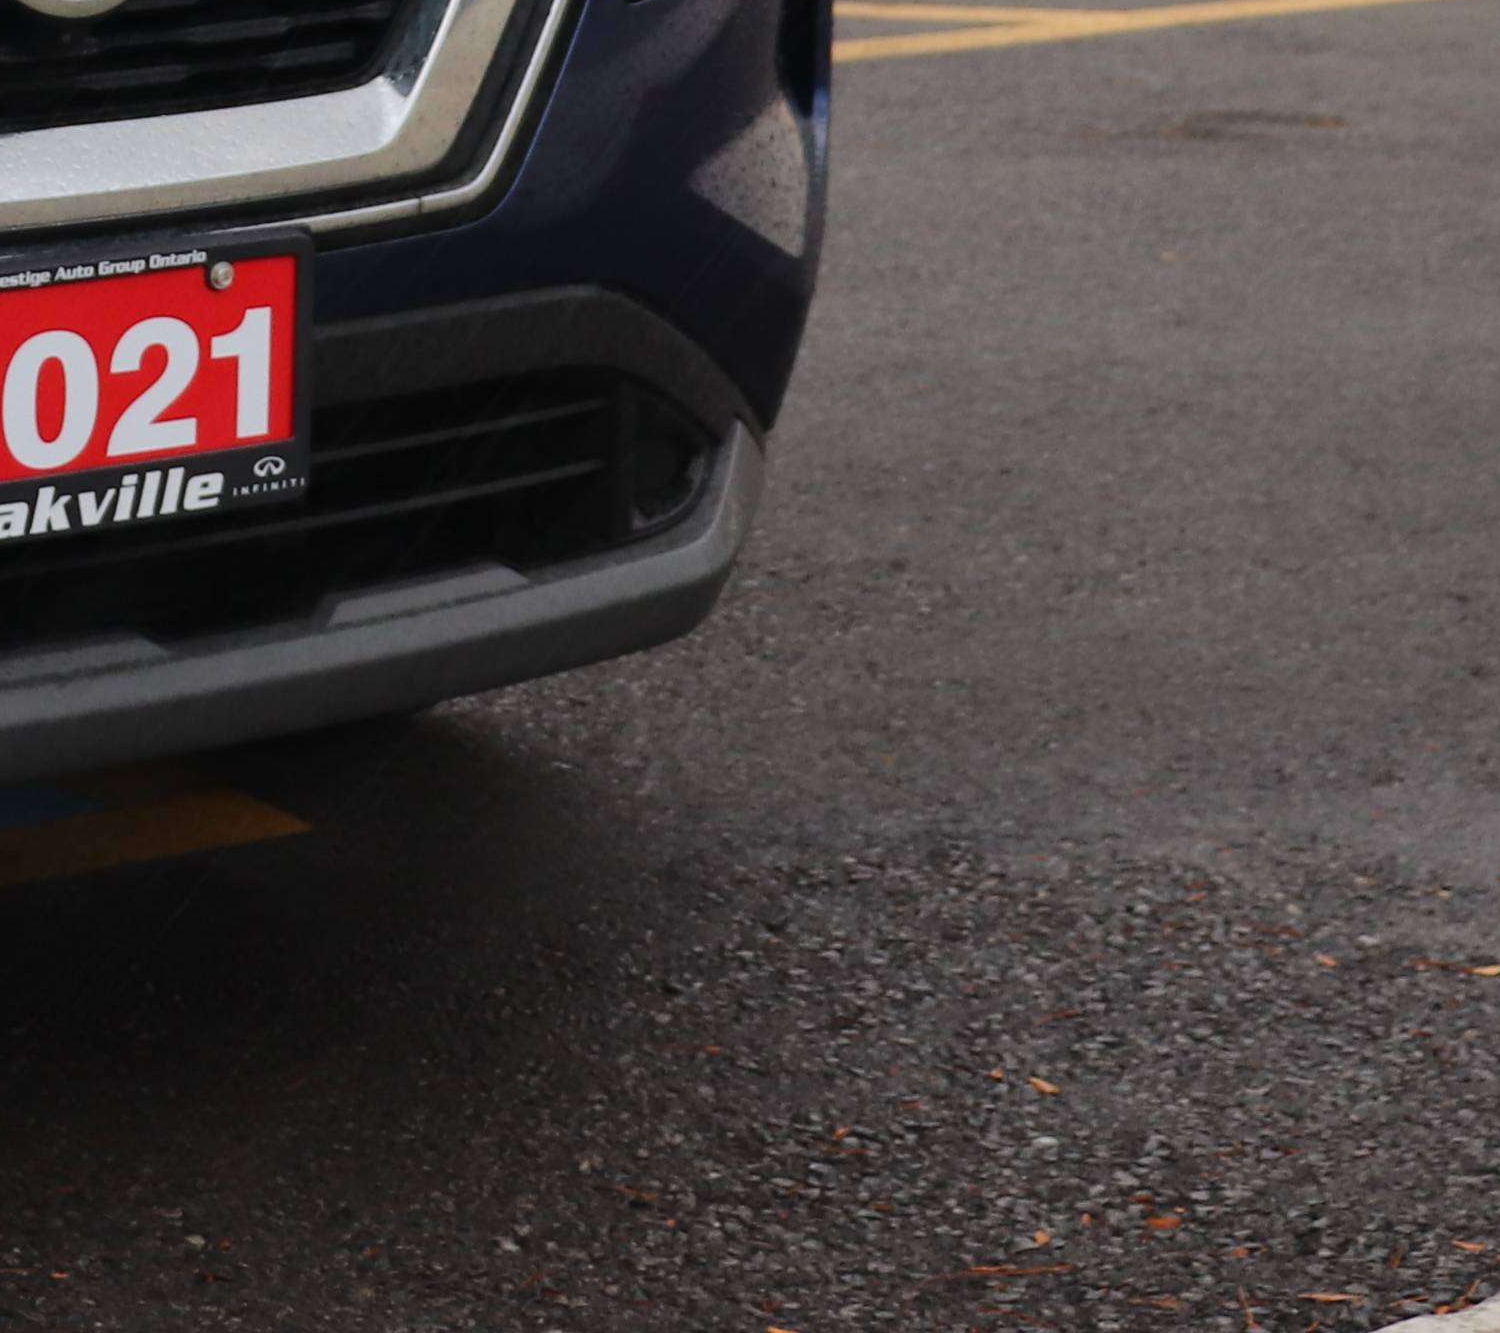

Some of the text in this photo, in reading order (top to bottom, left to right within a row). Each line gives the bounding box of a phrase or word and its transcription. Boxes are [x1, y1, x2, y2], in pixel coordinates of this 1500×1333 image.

[54, 264, 95, 282] Auto
[99, 257, 146, 275] Group
[149, 249, 208, 270] Ontario
[232, 476, 305, 497] INFINITI
